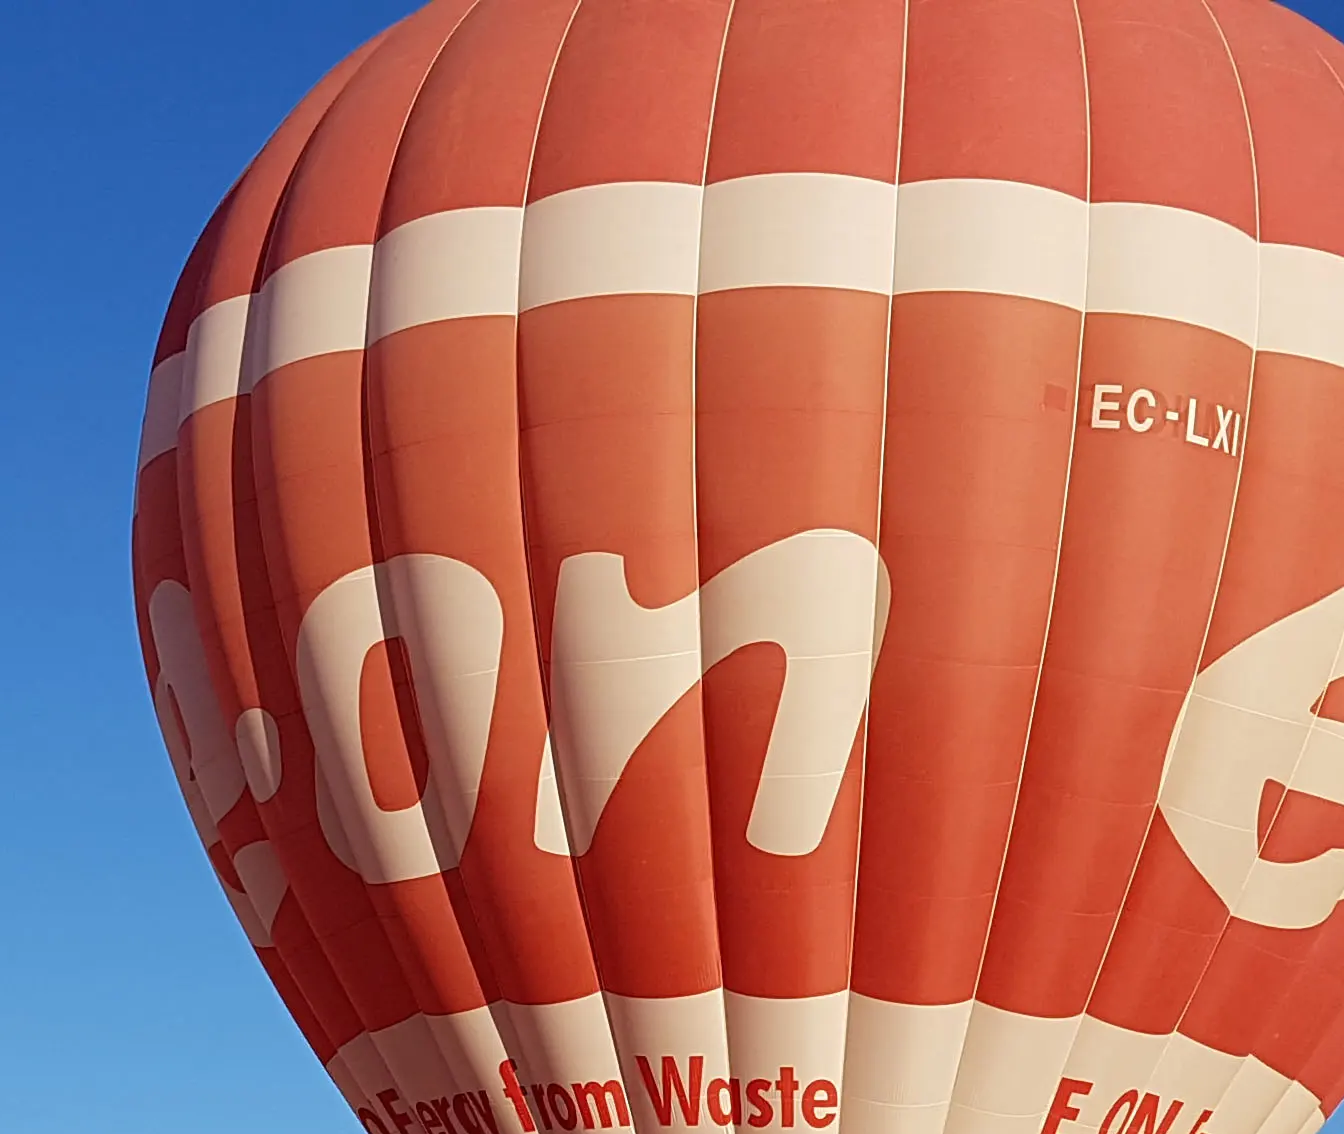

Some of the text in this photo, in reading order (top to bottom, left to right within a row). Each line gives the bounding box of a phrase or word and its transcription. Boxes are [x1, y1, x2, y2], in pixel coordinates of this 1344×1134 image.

[1091, 384, 1241, 457] EC-LXI
[499, 1058, 631, 1132] from
[636, 1055, 838, 1128] Waste
